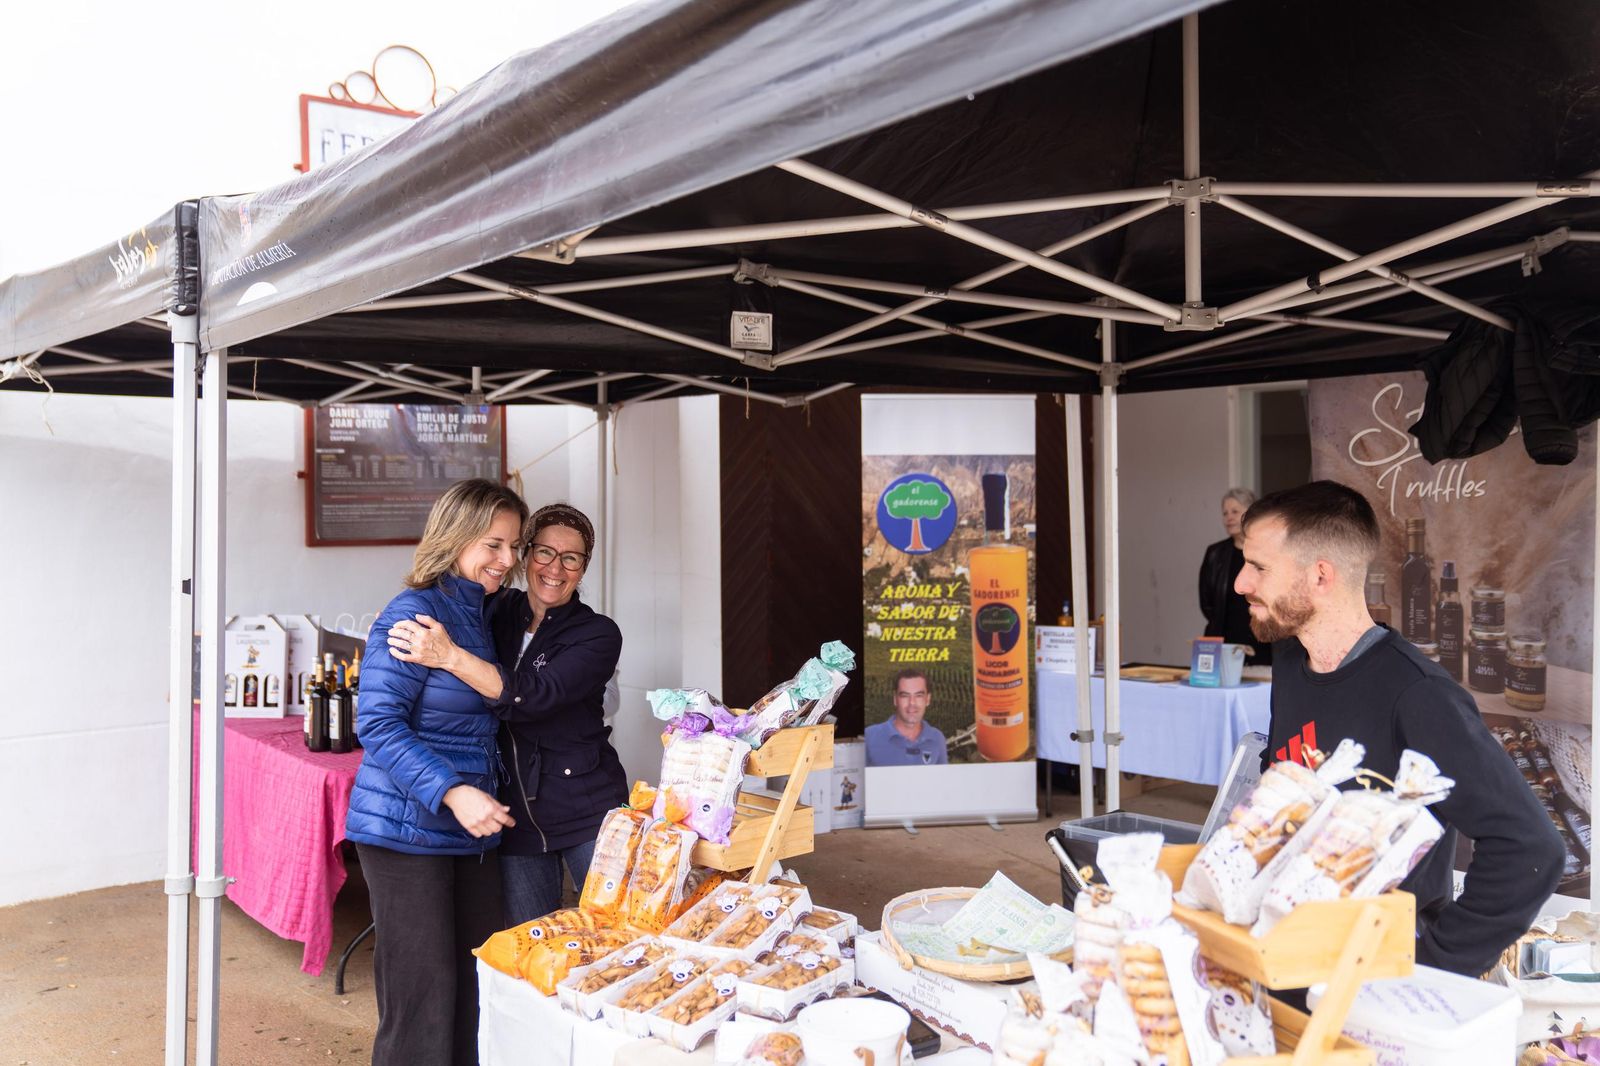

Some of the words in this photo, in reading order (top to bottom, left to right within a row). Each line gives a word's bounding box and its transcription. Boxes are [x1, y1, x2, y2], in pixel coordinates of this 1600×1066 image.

[256, 240, 297, 268] ALMERÍA
[329, 407, 360, 418] DANIEL
[363, 408, 391, 419] LUQUE
[416, 413, 446, 423] EMILIO
[448, 414, 460, 424] DE
[461, 415, 488, 425] JUSTO
[329, 418, 354, 429] JUAN
[355, 418, 389, 429] ORTEGA
[416, 423, 440, 433] ROCA
[442, 424, 459, 433] REY
[417, 433, 444, 443] JORGE
[446, 432, 488, 444] MARTÍNEZ
[911, 486, 921, 495] el
[1377, 453, 1487, 517] Truffles
[892, 497, 939, 509] gadorense
[990, 579, 1000, 588] EL
[880, 584, 943, 599] AROMA
[945, 581, 962, 598] Y
[877, 604, 937, 620] SABOR
[938, 604, 961, 620] DE
[880, 626, 958, 641] NUESTRA
[889, 647, 950, 662] TIERRA
